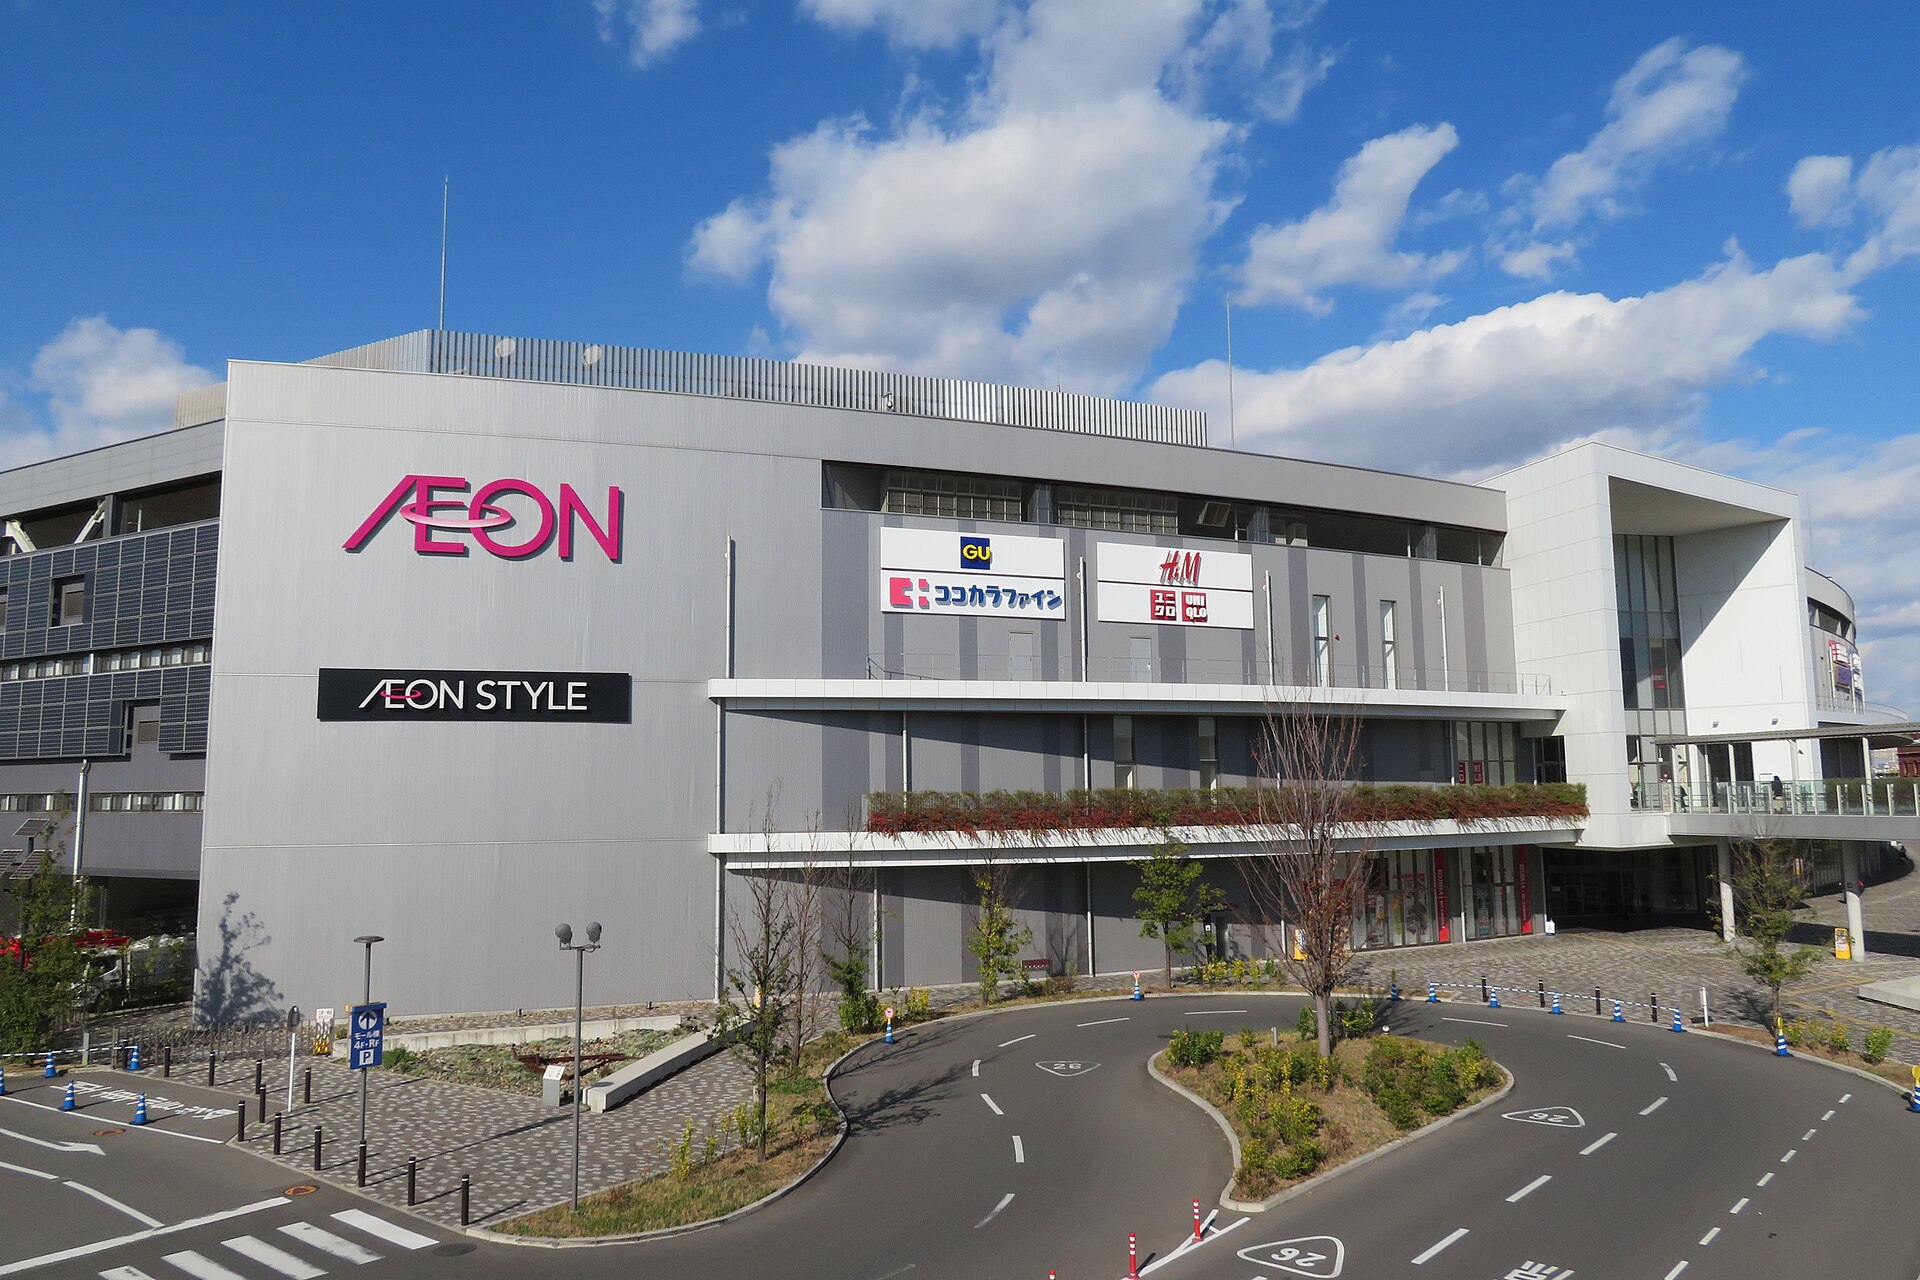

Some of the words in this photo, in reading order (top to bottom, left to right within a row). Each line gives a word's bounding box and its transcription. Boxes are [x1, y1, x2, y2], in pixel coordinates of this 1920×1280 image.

[962, 544, 991, 560] GU
[1160, 550, 1201, 583] H&M
[934, 584, 1062, 607] ココカラファイン
[475, 679, 588, 711] STYLE
[1528, 1112, 1569, 1123] 26
[1271, 1247, 1328, 1267] 26
